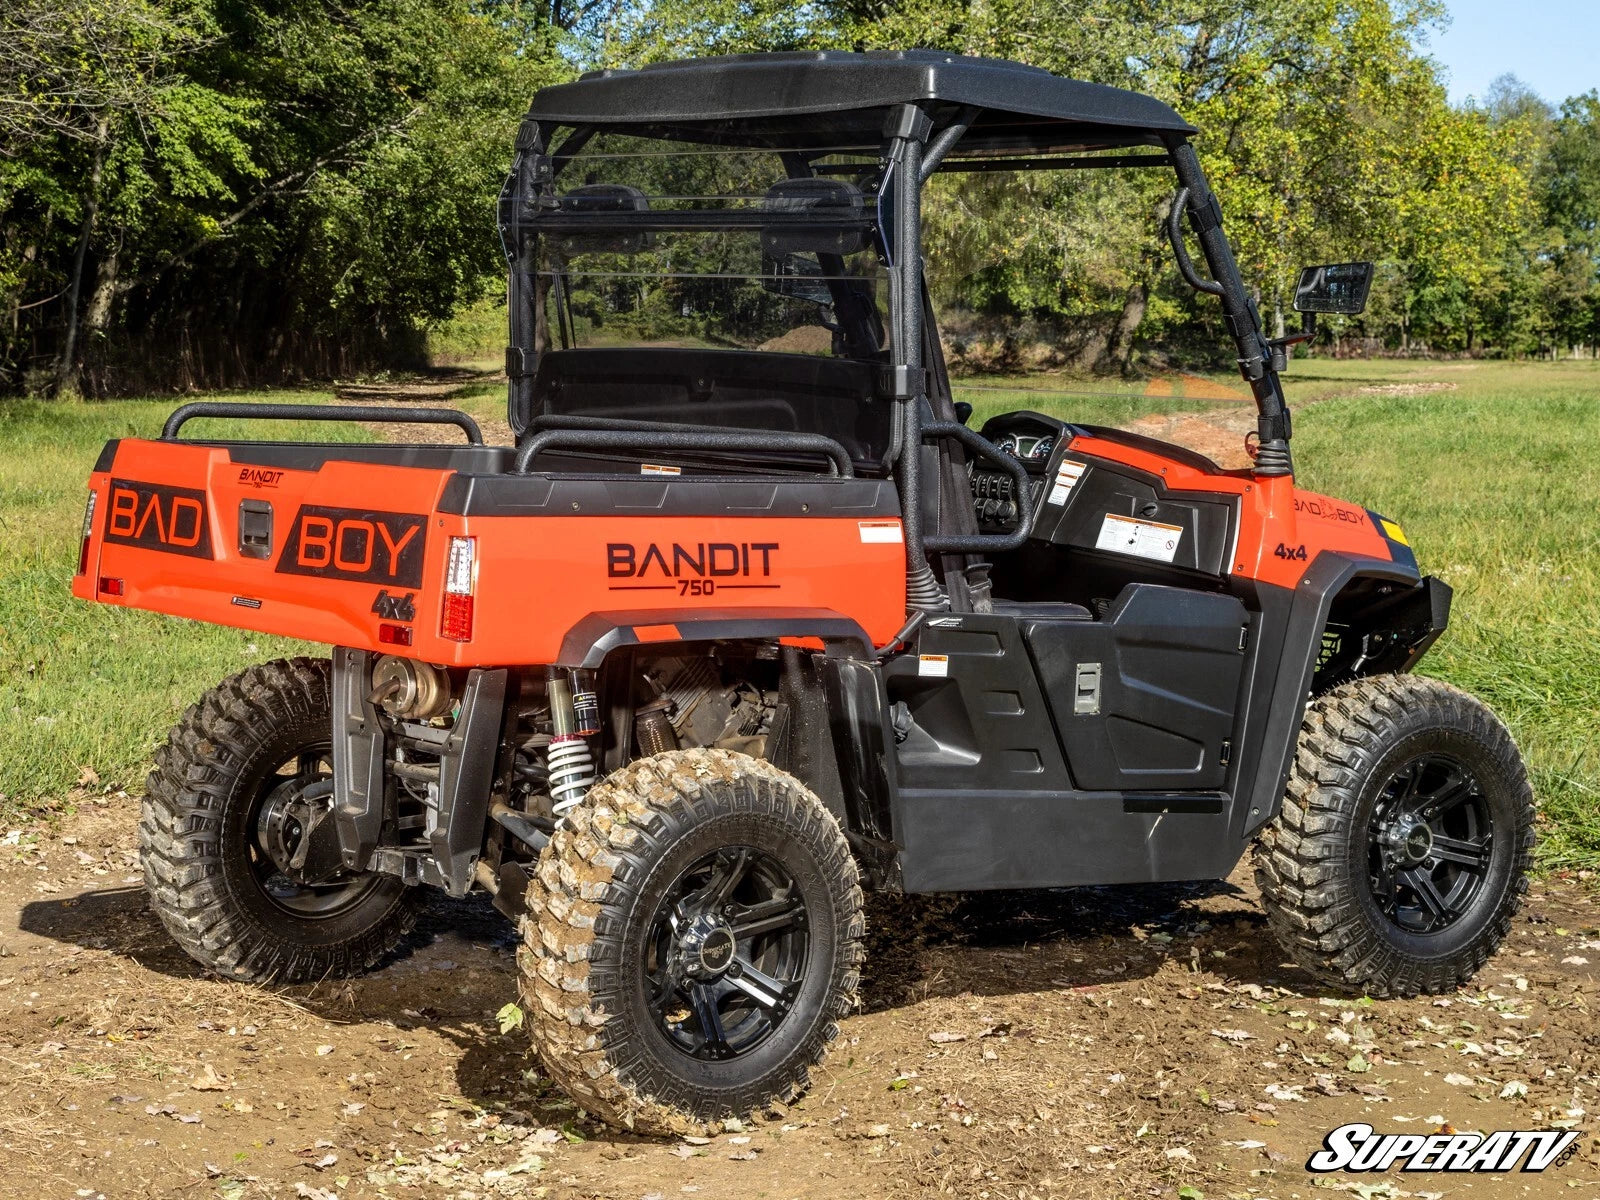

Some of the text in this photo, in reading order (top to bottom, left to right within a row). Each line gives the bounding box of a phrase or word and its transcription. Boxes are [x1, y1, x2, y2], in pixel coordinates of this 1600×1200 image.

[239, 468, 284, 484] BANDIT
[1336, 508, 1364, 526] BOY
[109, 488, 420, 576] BAD BOY
[606, 542, 779, 578] BANDIT
[1274, 543, 1307, 561] 4x4
[677, 580, 715, 596] 750
[371, 589, 416, 622] 4x4
